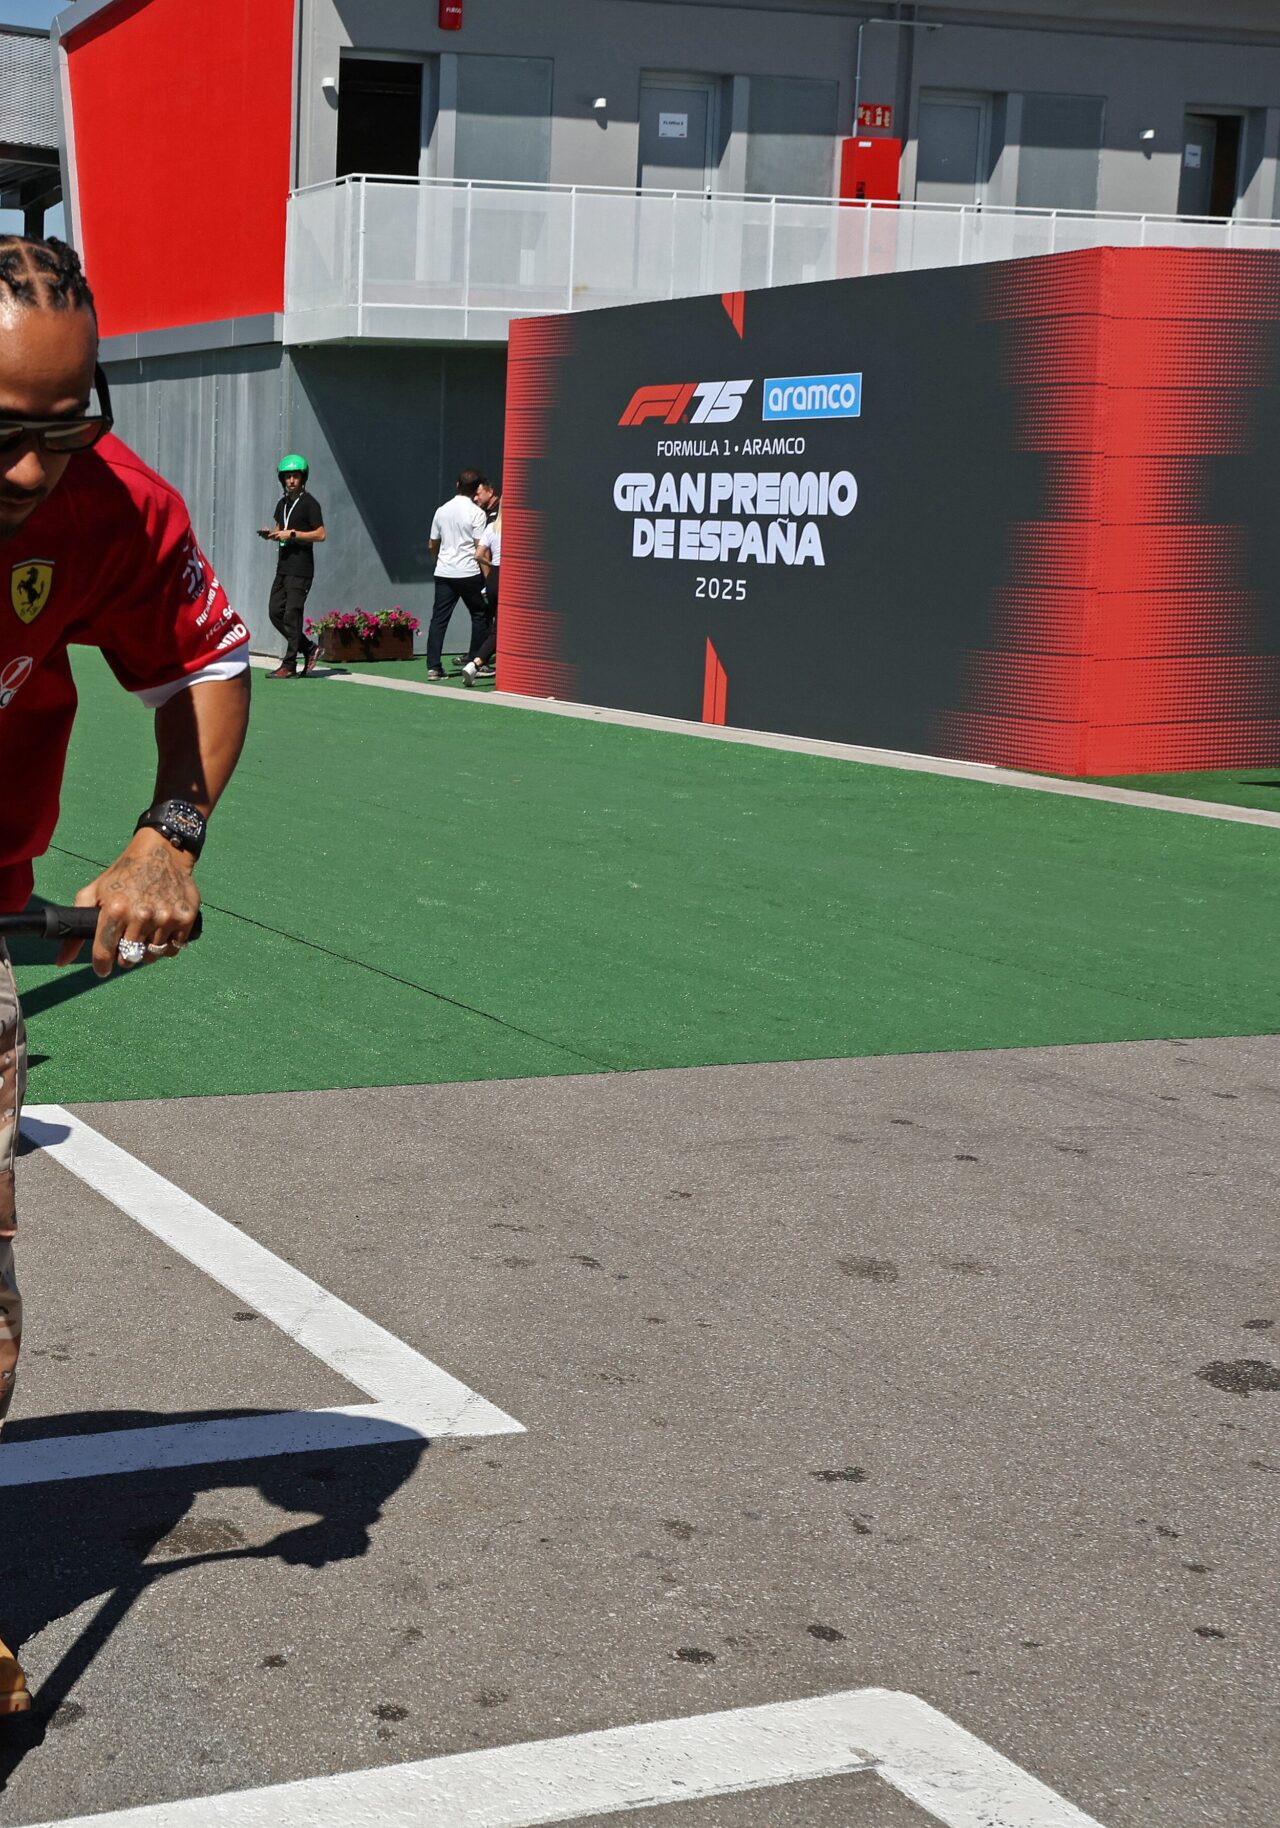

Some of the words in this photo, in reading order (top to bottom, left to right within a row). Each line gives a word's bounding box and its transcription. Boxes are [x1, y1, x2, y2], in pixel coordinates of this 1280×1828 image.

[768, 383, 856, 412] aramco
[656, 440, 719, 457] FORMULA
[723, 439, 731, 456] 1
[741, 437, 806, 456] ARAMCO
[613, 472, 706, 514] GRAN
[709, 470, 858, 517] PREMIO
[632, 518, 675, 559] DE
[678, 517, 826, 566] ESPAÑA
[695, 577, 747, 600] 2025
